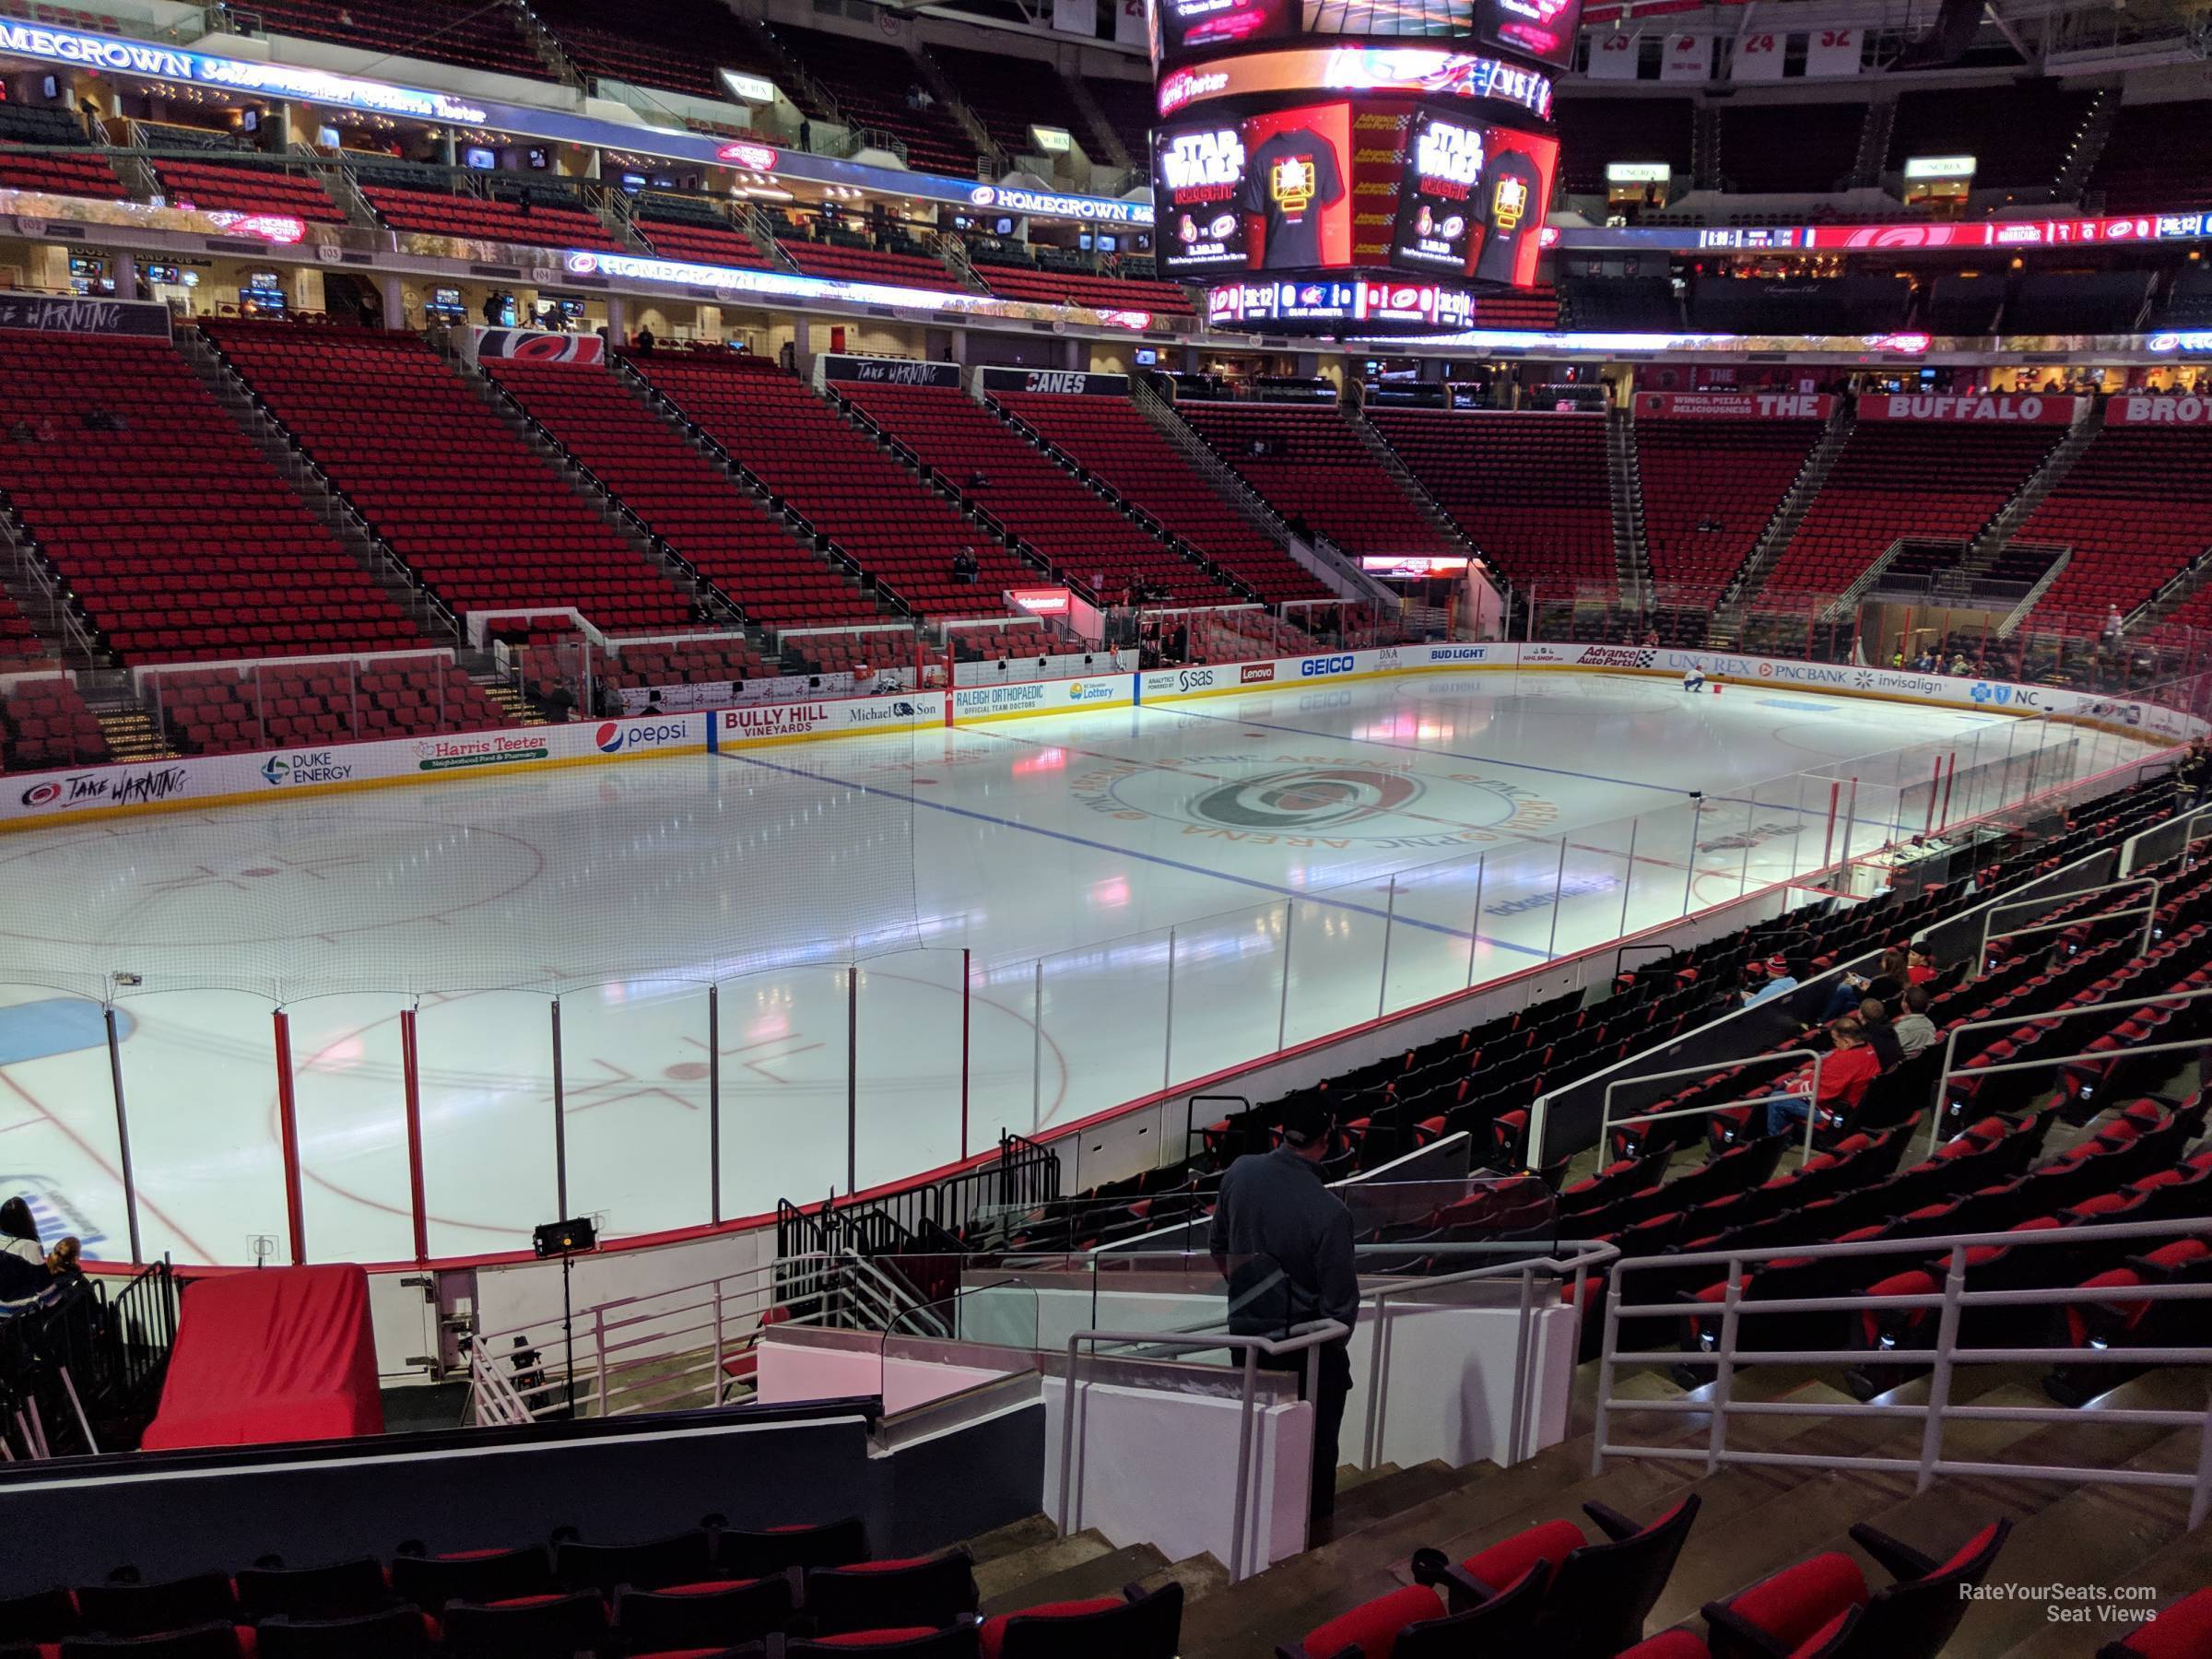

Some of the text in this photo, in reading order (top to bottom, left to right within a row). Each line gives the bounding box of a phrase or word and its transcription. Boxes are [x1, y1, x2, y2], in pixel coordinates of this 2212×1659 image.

[1173, 185, 1236, 205] NIGHT
[1420, 176, 1471, 201] NIGHT
[998, 190, 1128, 220] HOMEGROWN
[322, 249, 338, 258] 103
[535, 270, 550, 279] 104
[27, 299, 125, 333] WARNING
[857, 361, 939, 385] TAKE WARNING
[1025, 371, 1086, 394] CANES
[1672, 406, 1751, 415] DELICIOUSNESS
[1674, 396, 1712, 406] WINGS,
[1712, 397, 1741, 406] PIZZA
[1756, 395, 1819, 417] THE
[1888, 396, 2043, 420] BUFFALO
[1430, 648, 1485, 660] BUD LIGHT
[1577, 656, 1635, 667] Auto Parts
[1584, 647, 1636, 660] Advance
[1242, 668, 1272, 679] Lenovo
[1301, 655, 1354, 677] GEICO
[1668, 653, 1751, 675] UNC REX
[1148, 676, 1174, 685] ANALYTICS
[1878, 675, 1944, 694] invisalign
[956, 685, 1044, 708] RALEIGH ORTHOPAEDIC
[1083, 687, 1114, 700] Lottery
[2015, 689, 2039, 707] NC
[725, 704, 829, 729] BULLY HILL
[850, 706, 891, 723] Michael
[916, 702, 936, 715] Son
[964, 701, 1036, 715] OFFICIAL TEAM DOCTORS
[629, 720, 687, 747] pepsi
[745, 722, 812, 738] VINEYARDS
[435, 735, 547, 758] Harris Teeter
[293, 752, 332, 768] DUKE
[294, 765, 352, 783] ENERGY
[65, 766, 192, 805] TAKE WARNING
